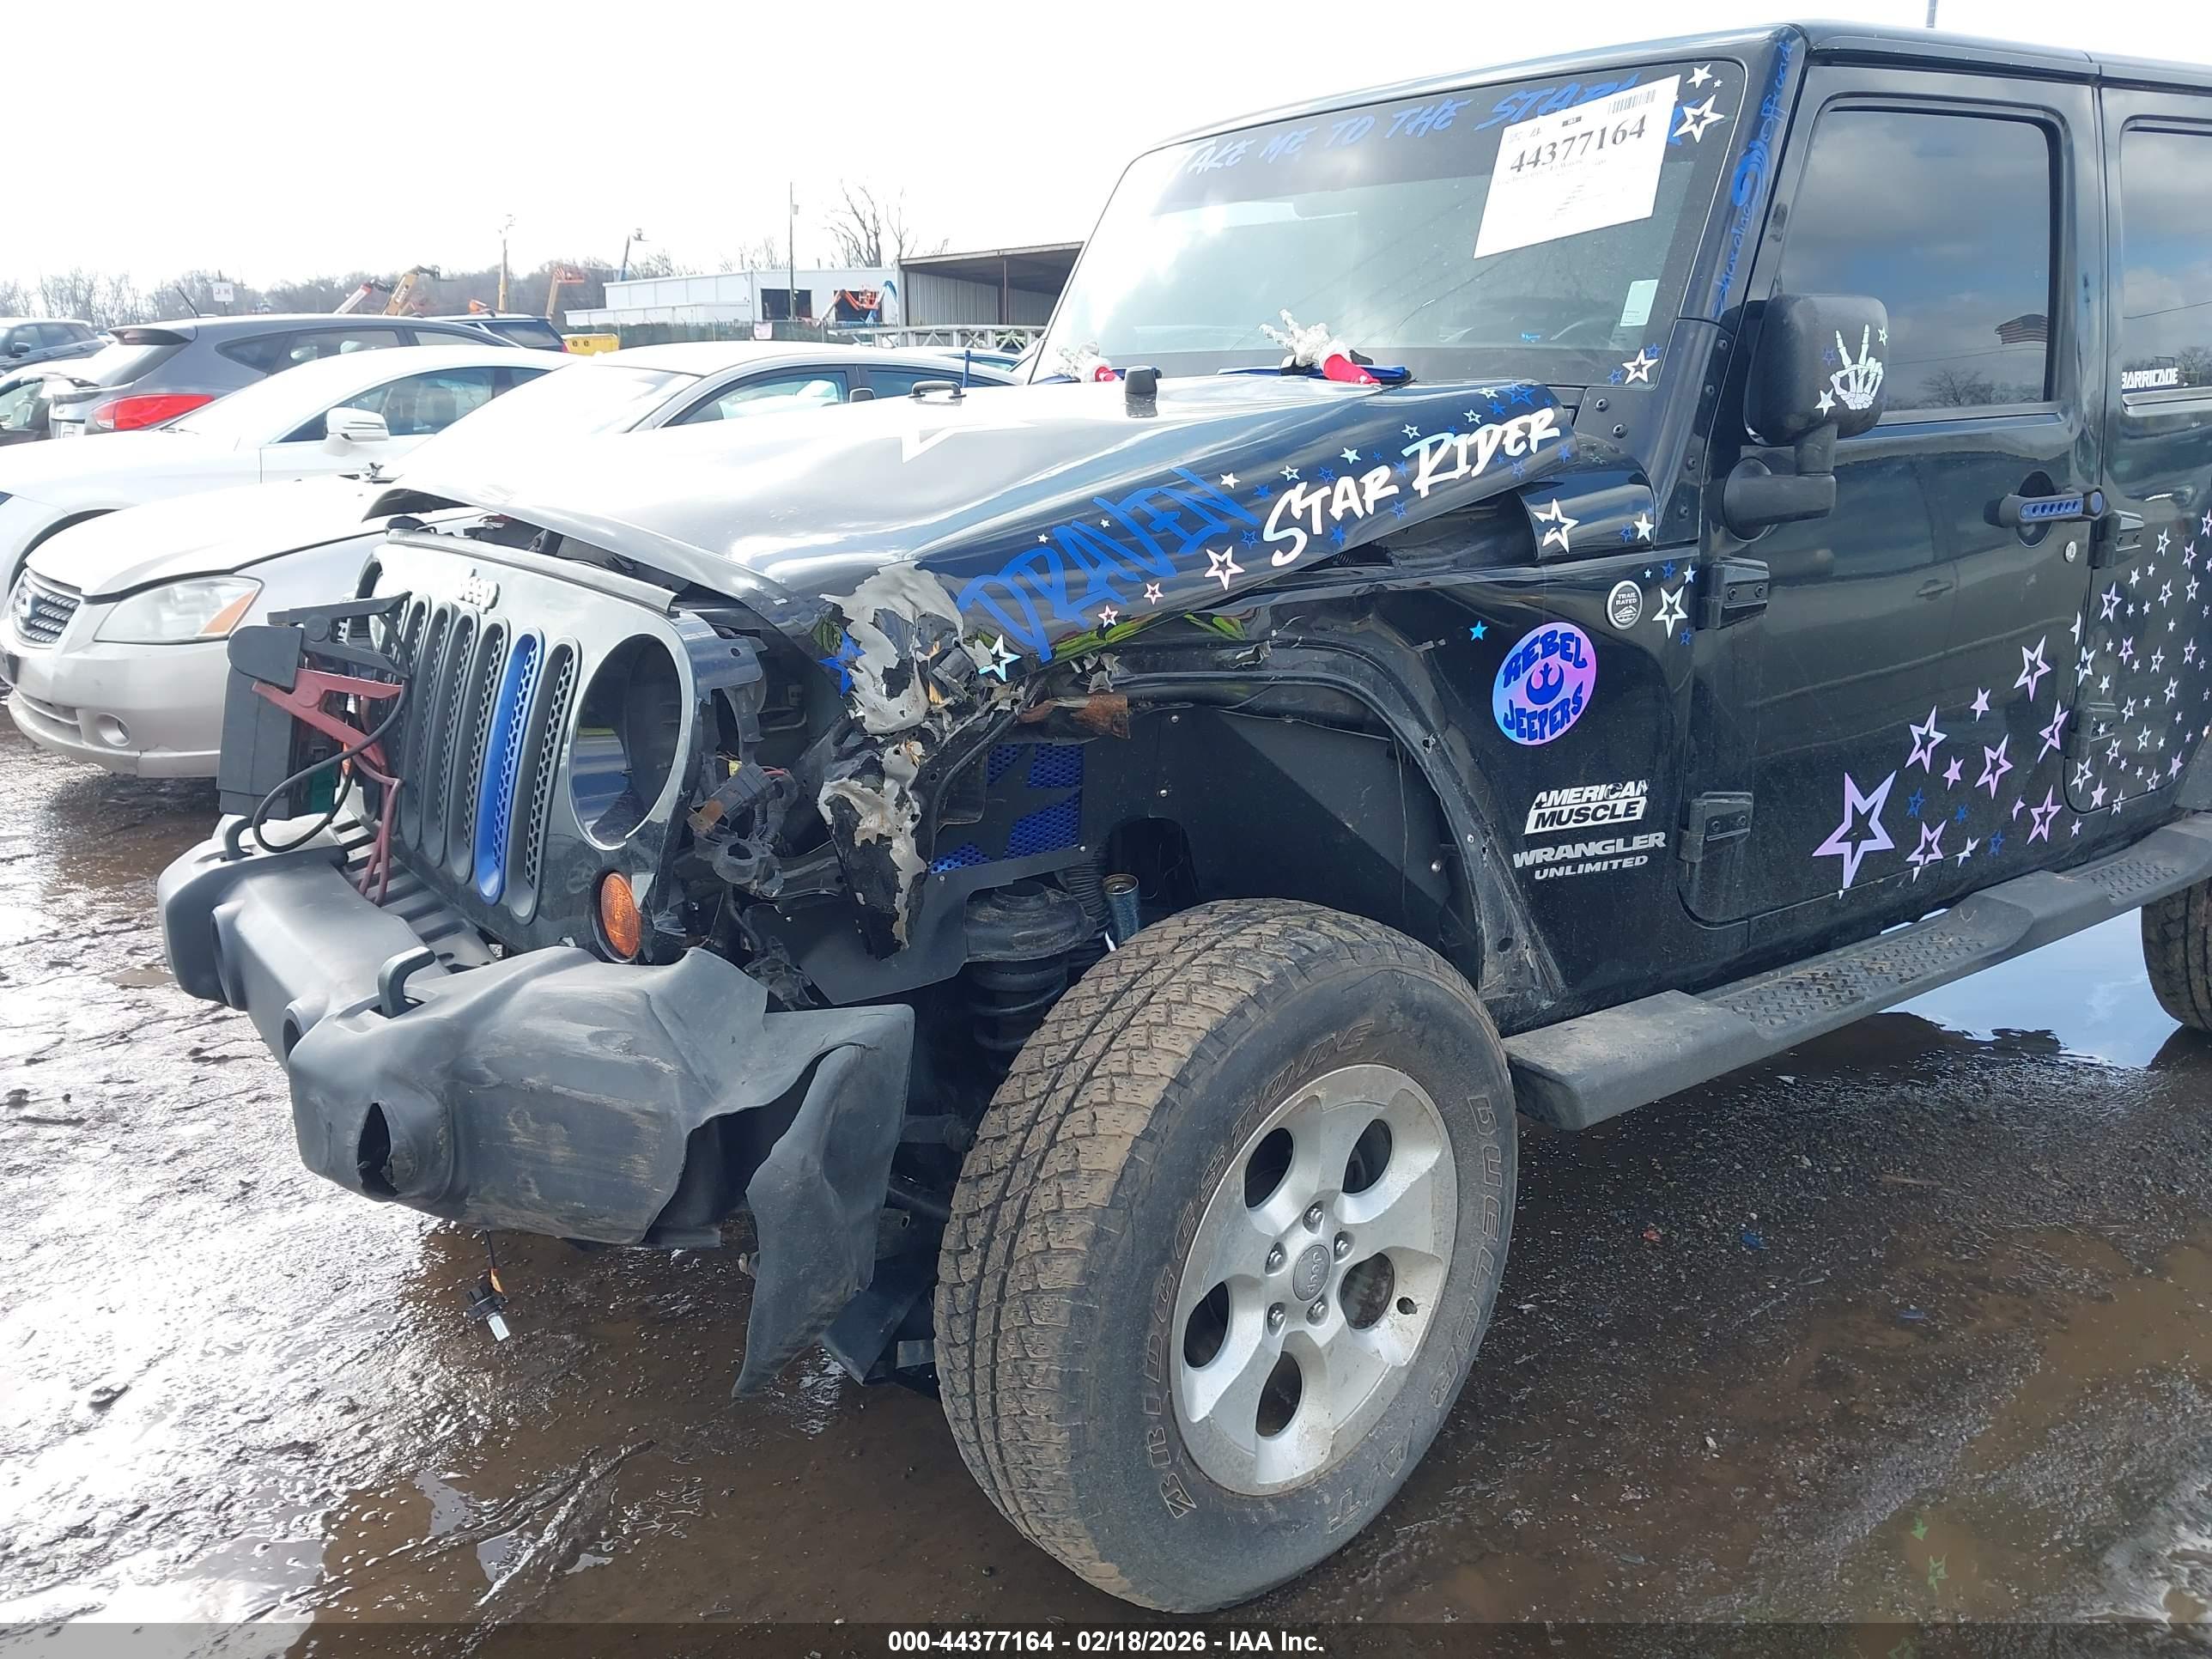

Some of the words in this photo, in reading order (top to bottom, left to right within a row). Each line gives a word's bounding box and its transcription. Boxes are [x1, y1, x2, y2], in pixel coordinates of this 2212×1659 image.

[1176, 136, 1256, 175] TAKE
[1258, 126, 1319, 164] ME
[1323, 114, 1376, 149] TO
[1384, 98, 1473, 138] THE
[1510, 114, 1647, 173] 44377164
[2122, 367, 2179, 390] BARRICADE
[1262, 465, 1400, 568] STAR
[1401, 407, 1562, 499] RIDER
[956, 466, 1261, 665] DRAVEN
[1615, 598, 1638, 606] RATED
[1503, 629, 1588, 689] REBEL
[1503, 681, 1583, 741] JEEPERS
[1533, 779, 1650, 811] AMERICAN
[1534, 799, 1638, 830] MUSCLE
[1512, 831, 1667, 869] WRANGLER
[1534, 854, 1649, 881] UNLIMITED
[1144, 1019, 1375, 1520] BRIDGESTONE
[1430, 1095, 1503, 1408] DUELER
[1305, 1251, 1323, 1292] Jeep
